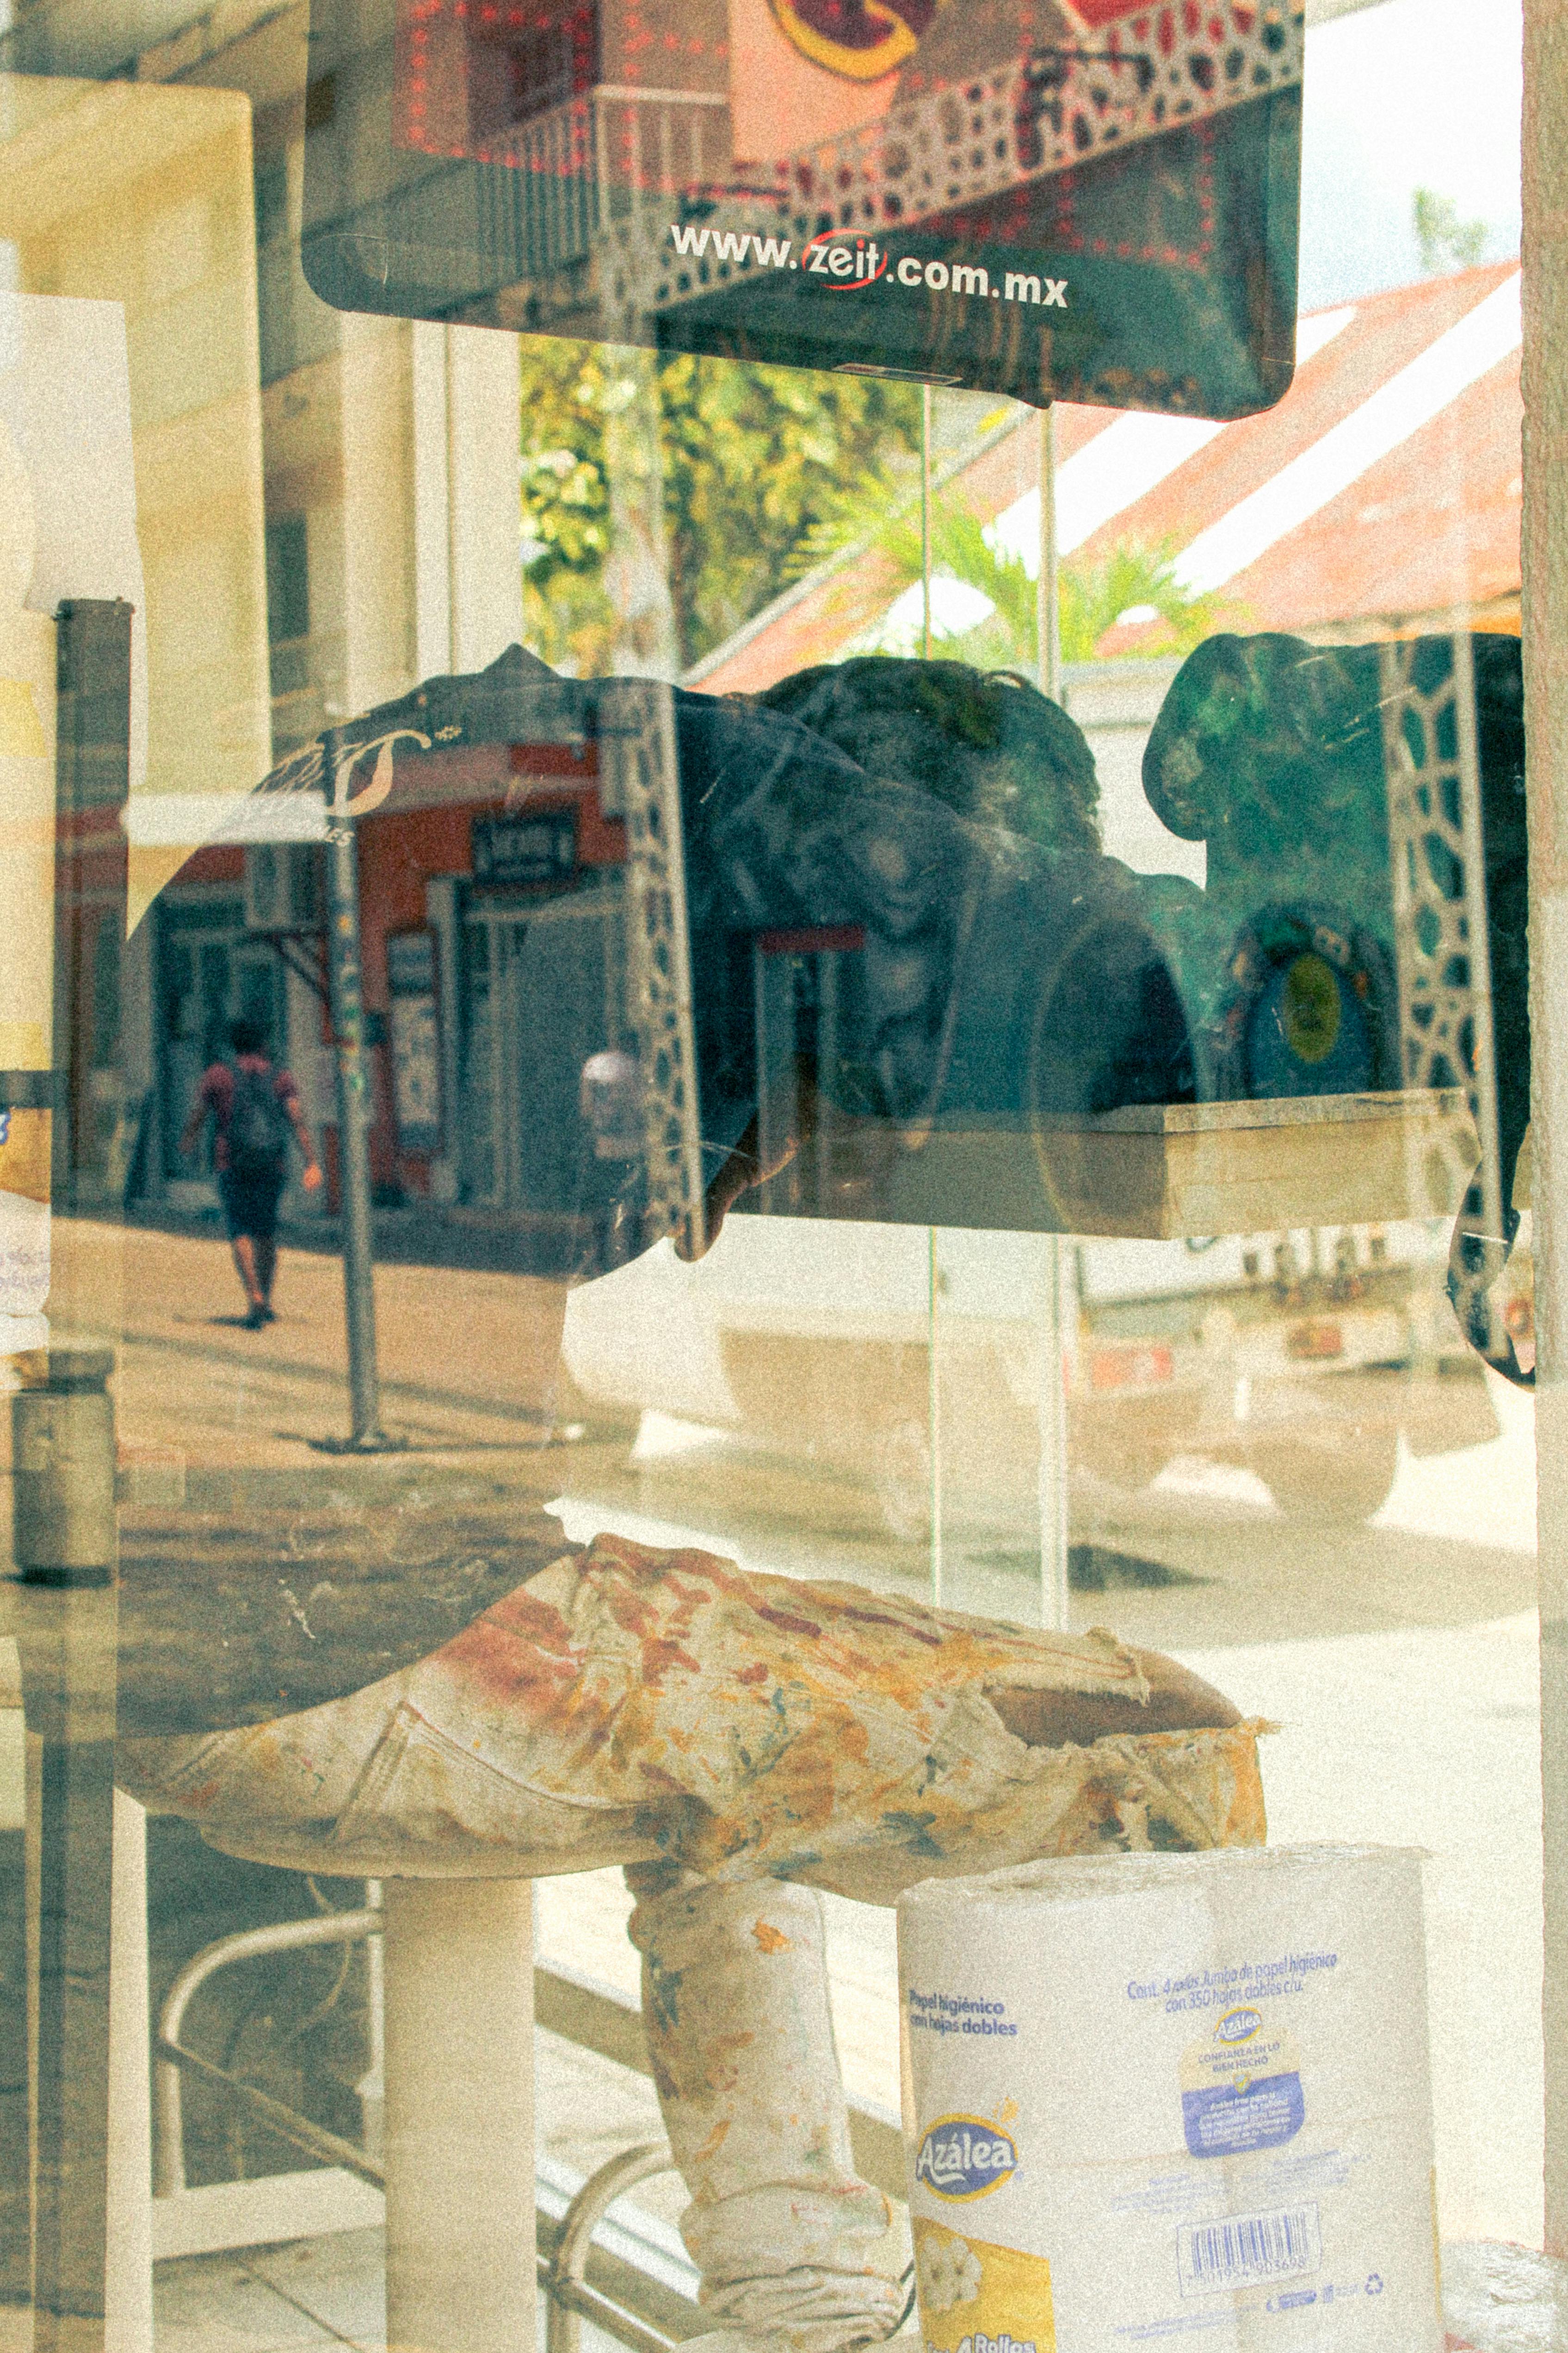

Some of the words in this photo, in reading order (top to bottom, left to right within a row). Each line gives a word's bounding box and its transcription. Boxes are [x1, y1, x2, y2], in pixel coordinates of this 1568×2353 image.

[670, 224, 1069, 309] www.zeit.com.mx
[1240, 1962, 1253, 1980] de
[1255, 1955, 1287, 1983] papel
[1189, 1989, 1210, 2009] 350
[962, 2018, 1018, 2036] dobles
[1214, 2014, 1262, 2042] Azálea
[917, 2132, 1013, 2185] Azálea
